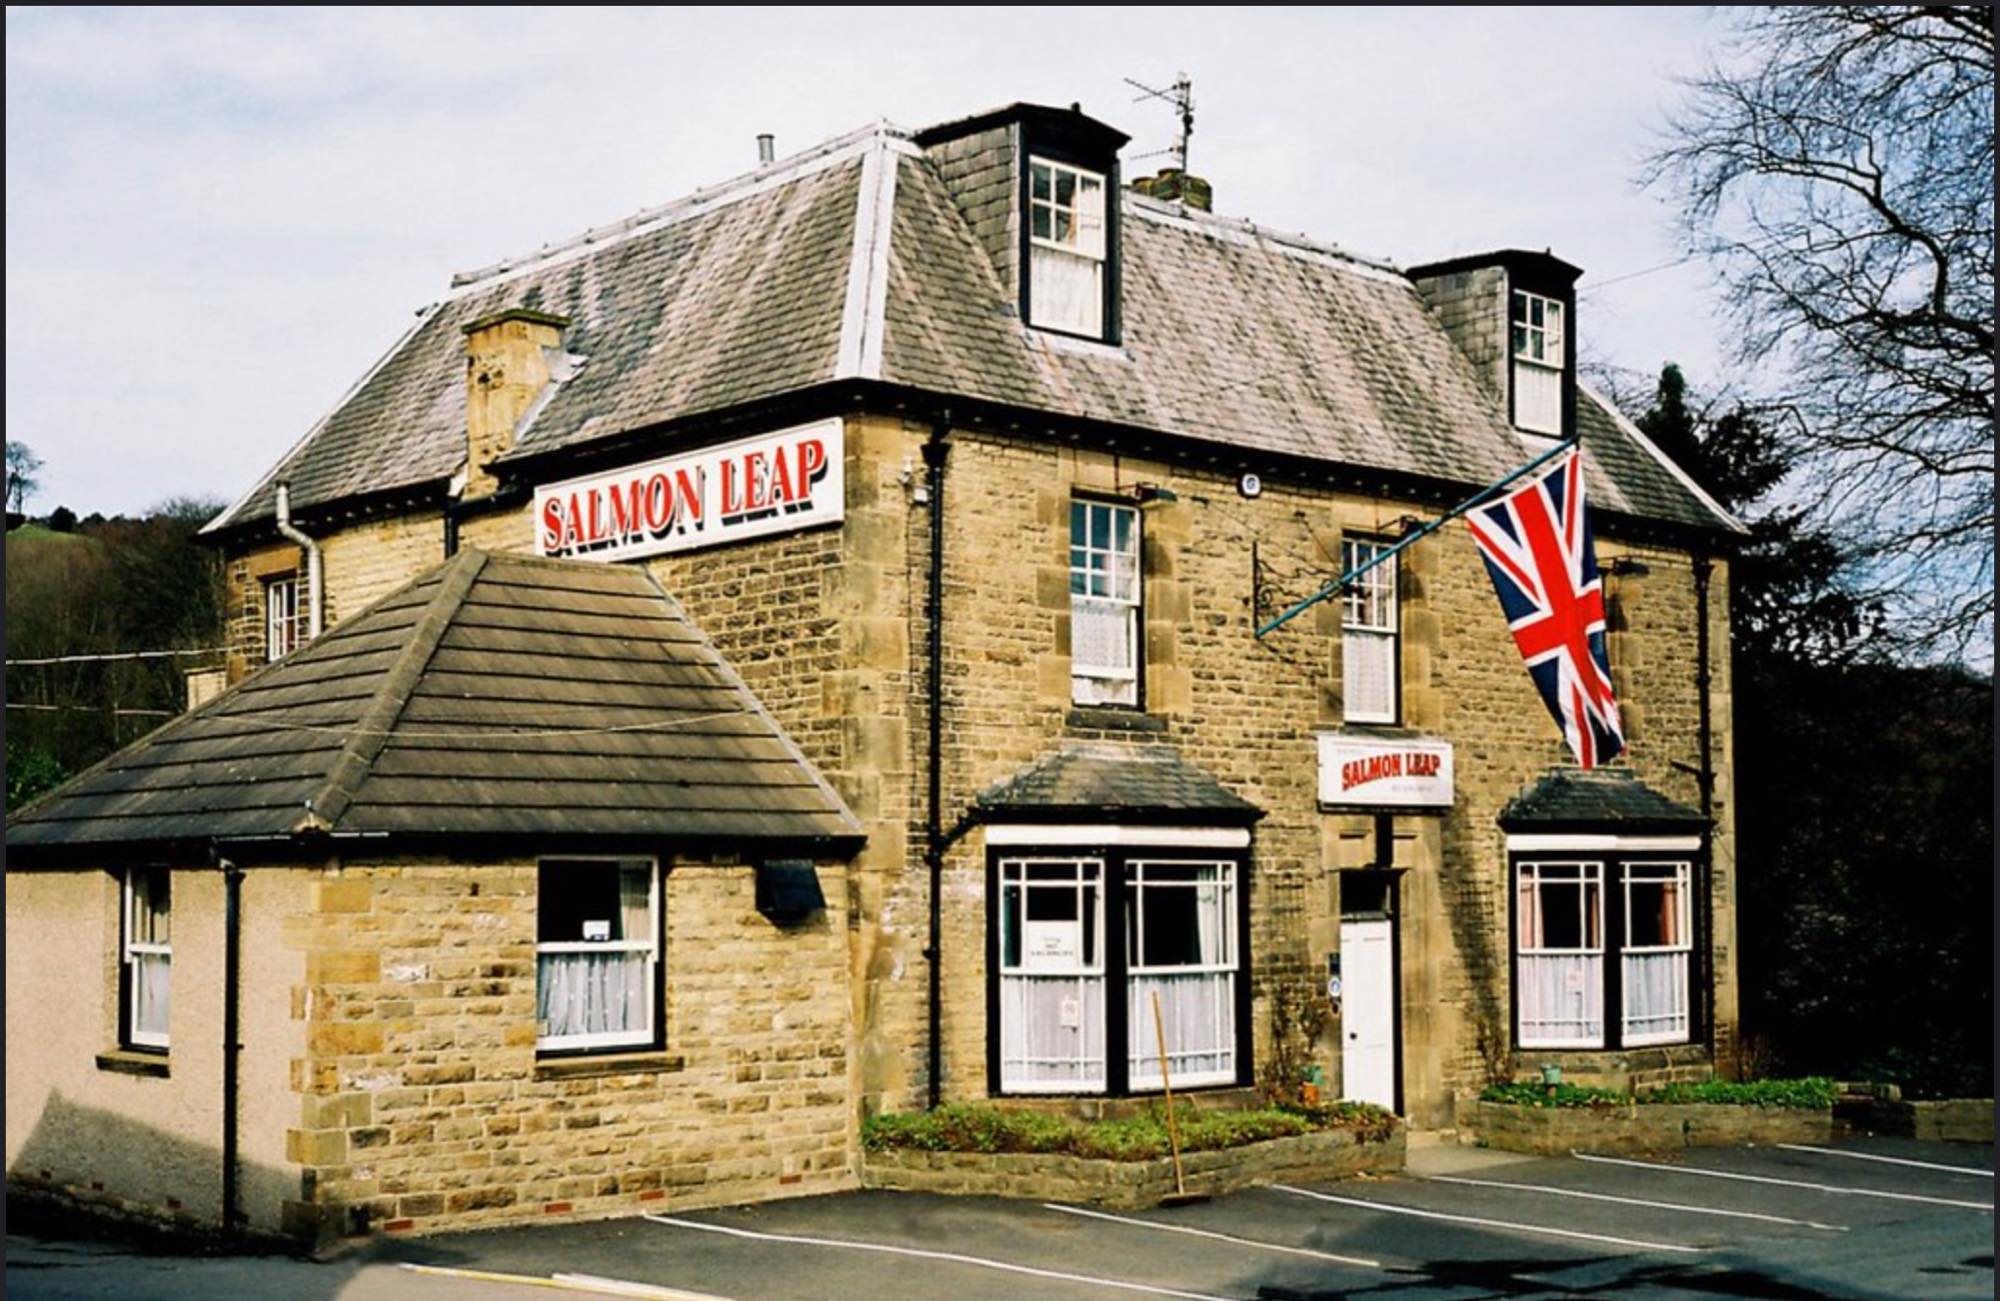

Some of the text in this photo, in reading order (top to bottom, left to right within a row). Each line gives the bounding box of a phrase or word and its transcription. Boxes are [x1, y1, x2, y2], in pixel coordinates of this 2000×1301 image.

[543, 439, 829, 556] SALMON LEAP
[1342, 752, 1441, 791] SALMON LEAP
